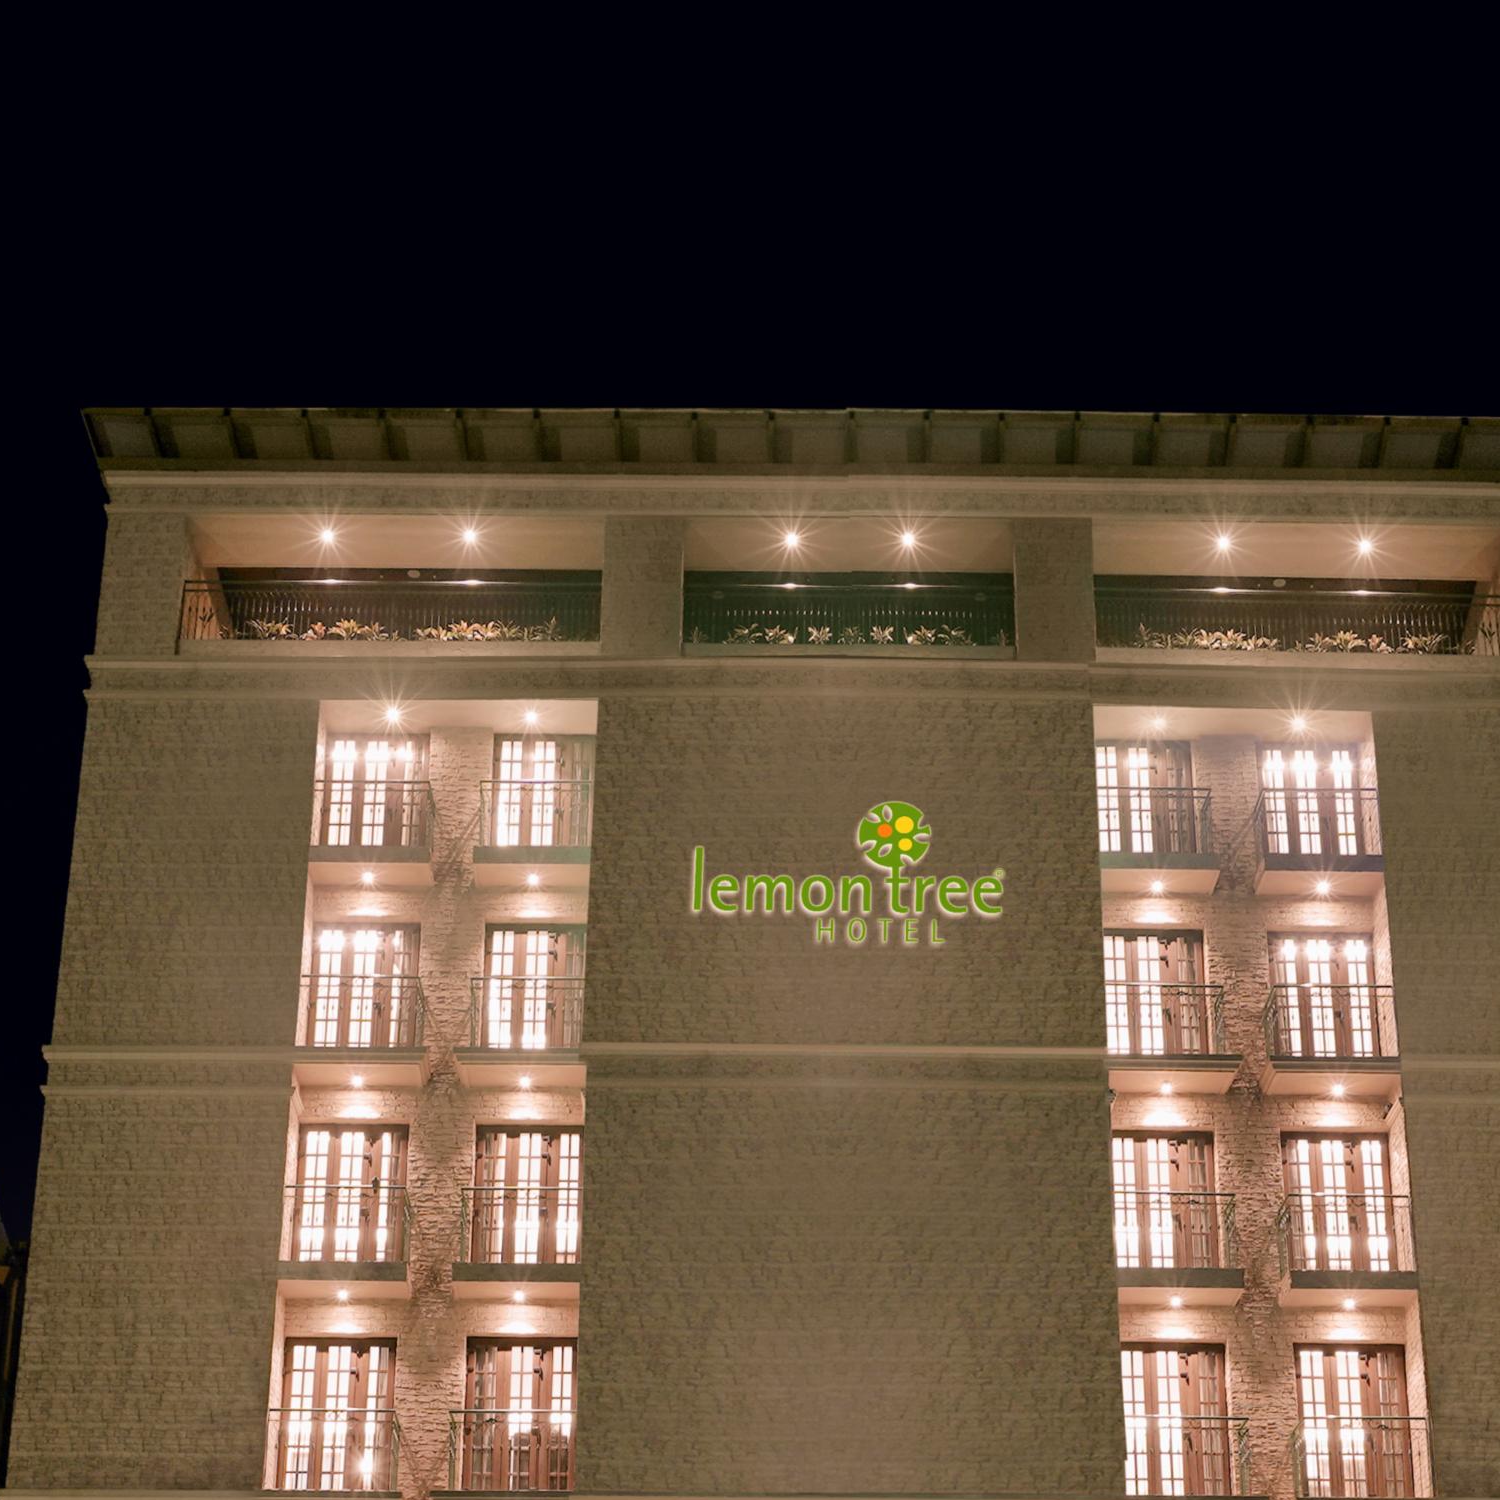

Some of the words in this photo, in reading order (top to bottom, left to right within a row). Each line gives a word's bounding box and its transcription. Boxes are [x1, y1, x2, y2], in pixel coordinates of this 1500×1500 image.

[693, 846, 871, 913] lemon
[885, 873, 1004, 914] tree
[815, 918, 946, 943] HOTEL
